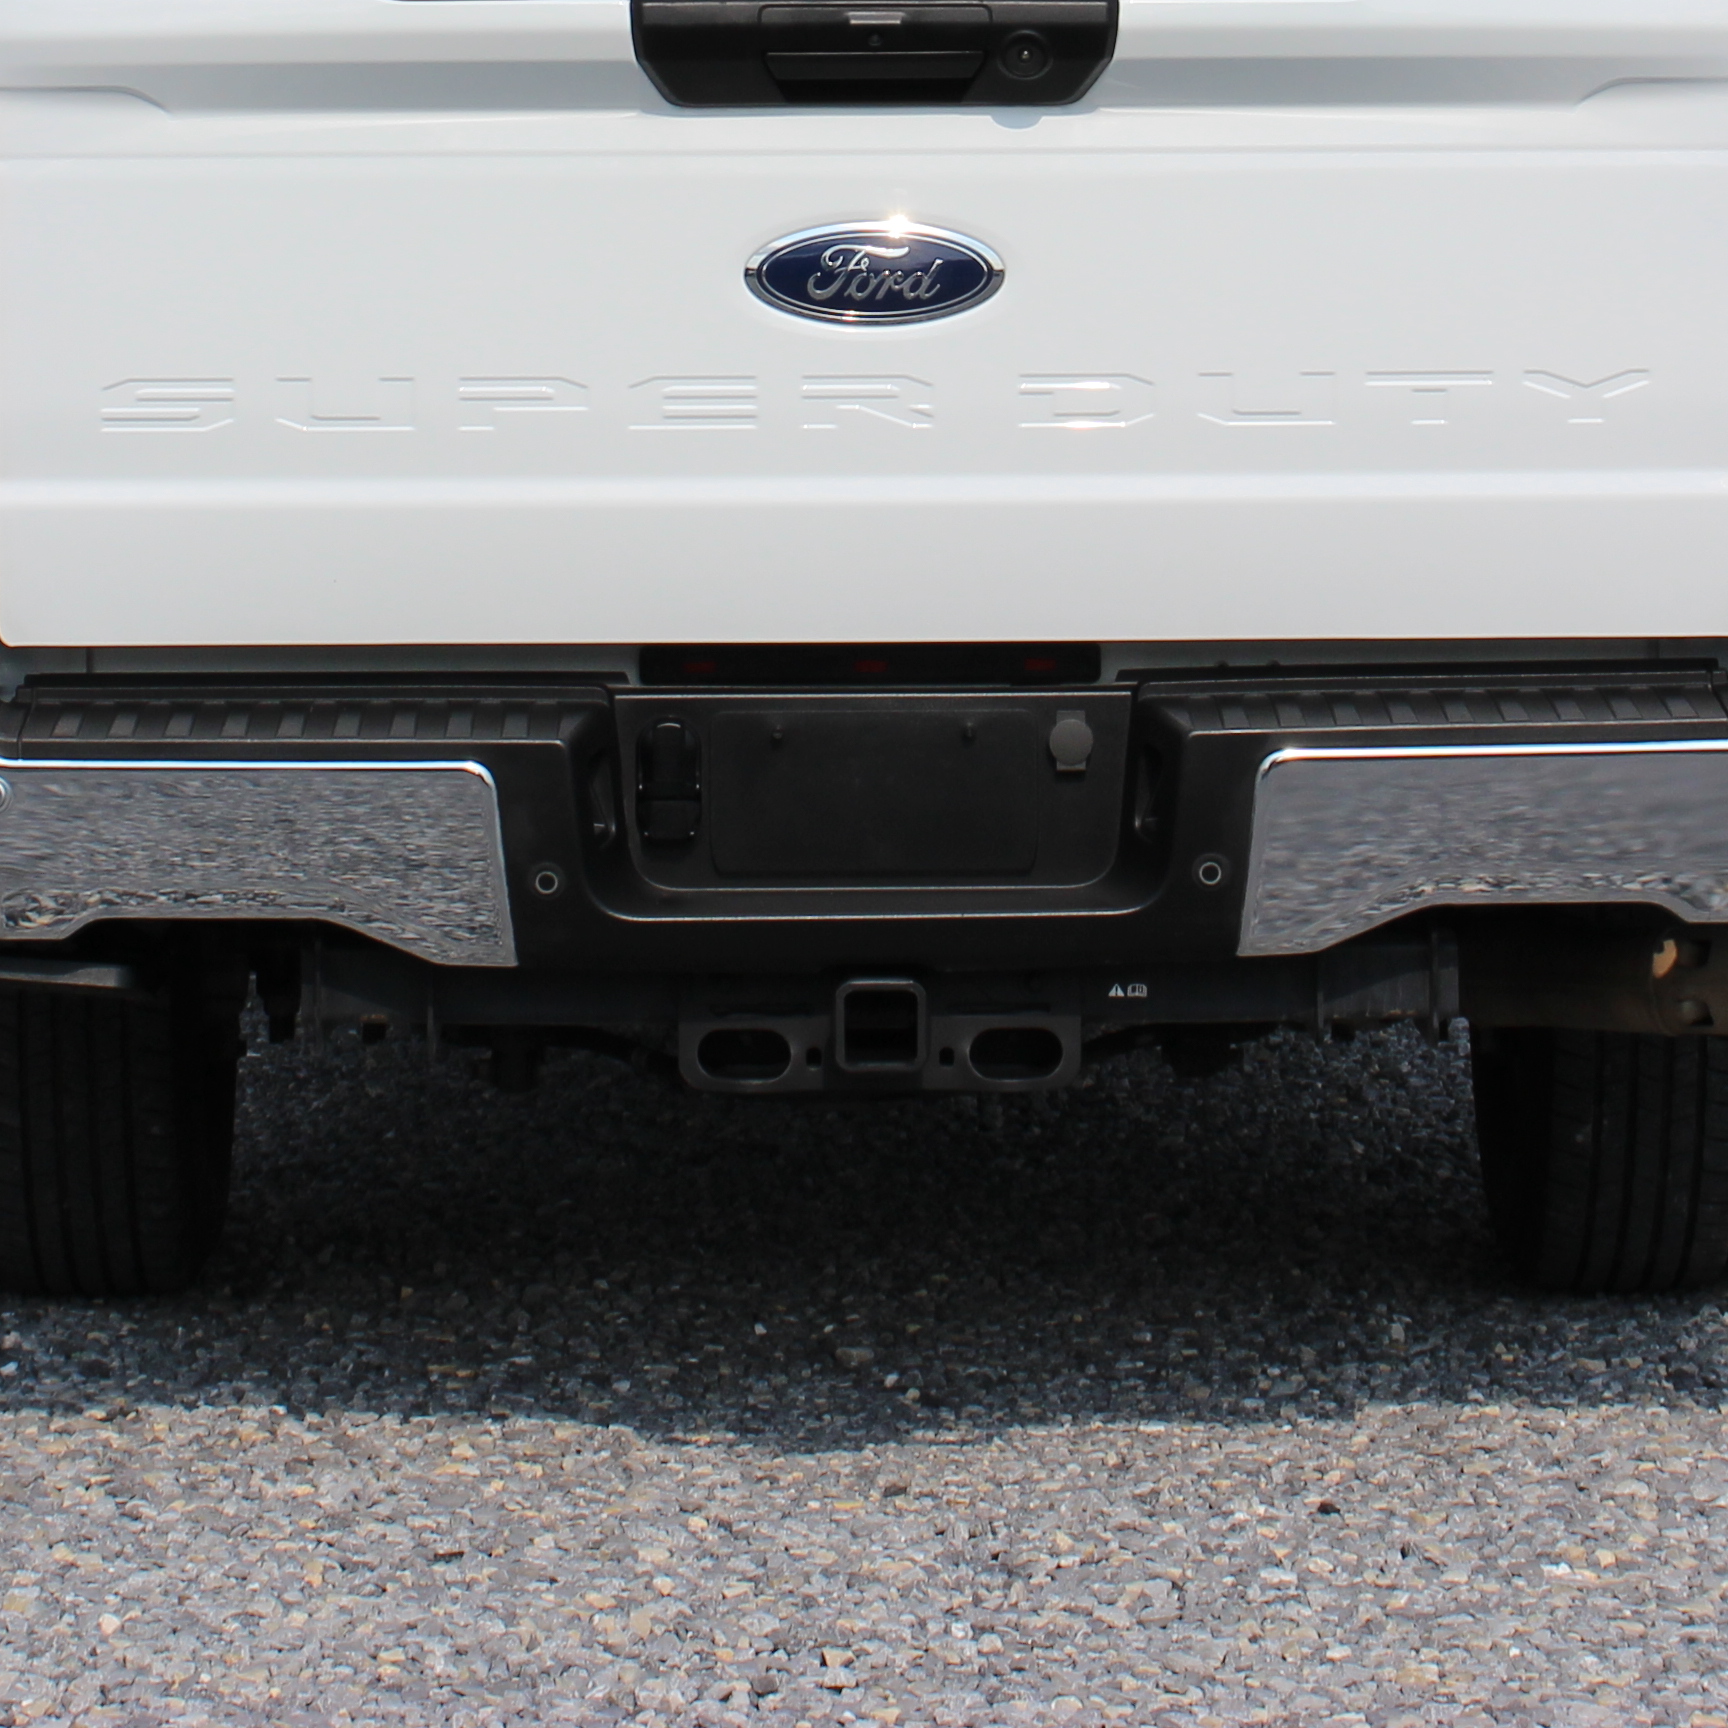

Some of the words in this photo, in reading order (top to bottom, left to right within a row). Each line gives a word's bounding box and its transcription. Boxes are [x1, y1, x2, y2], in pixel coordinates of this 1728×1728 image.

[807, 243, 943, 300] Ford
[101, 374, 935, 432] SUPER
[1018, 368, 1651, 427] DUTY
